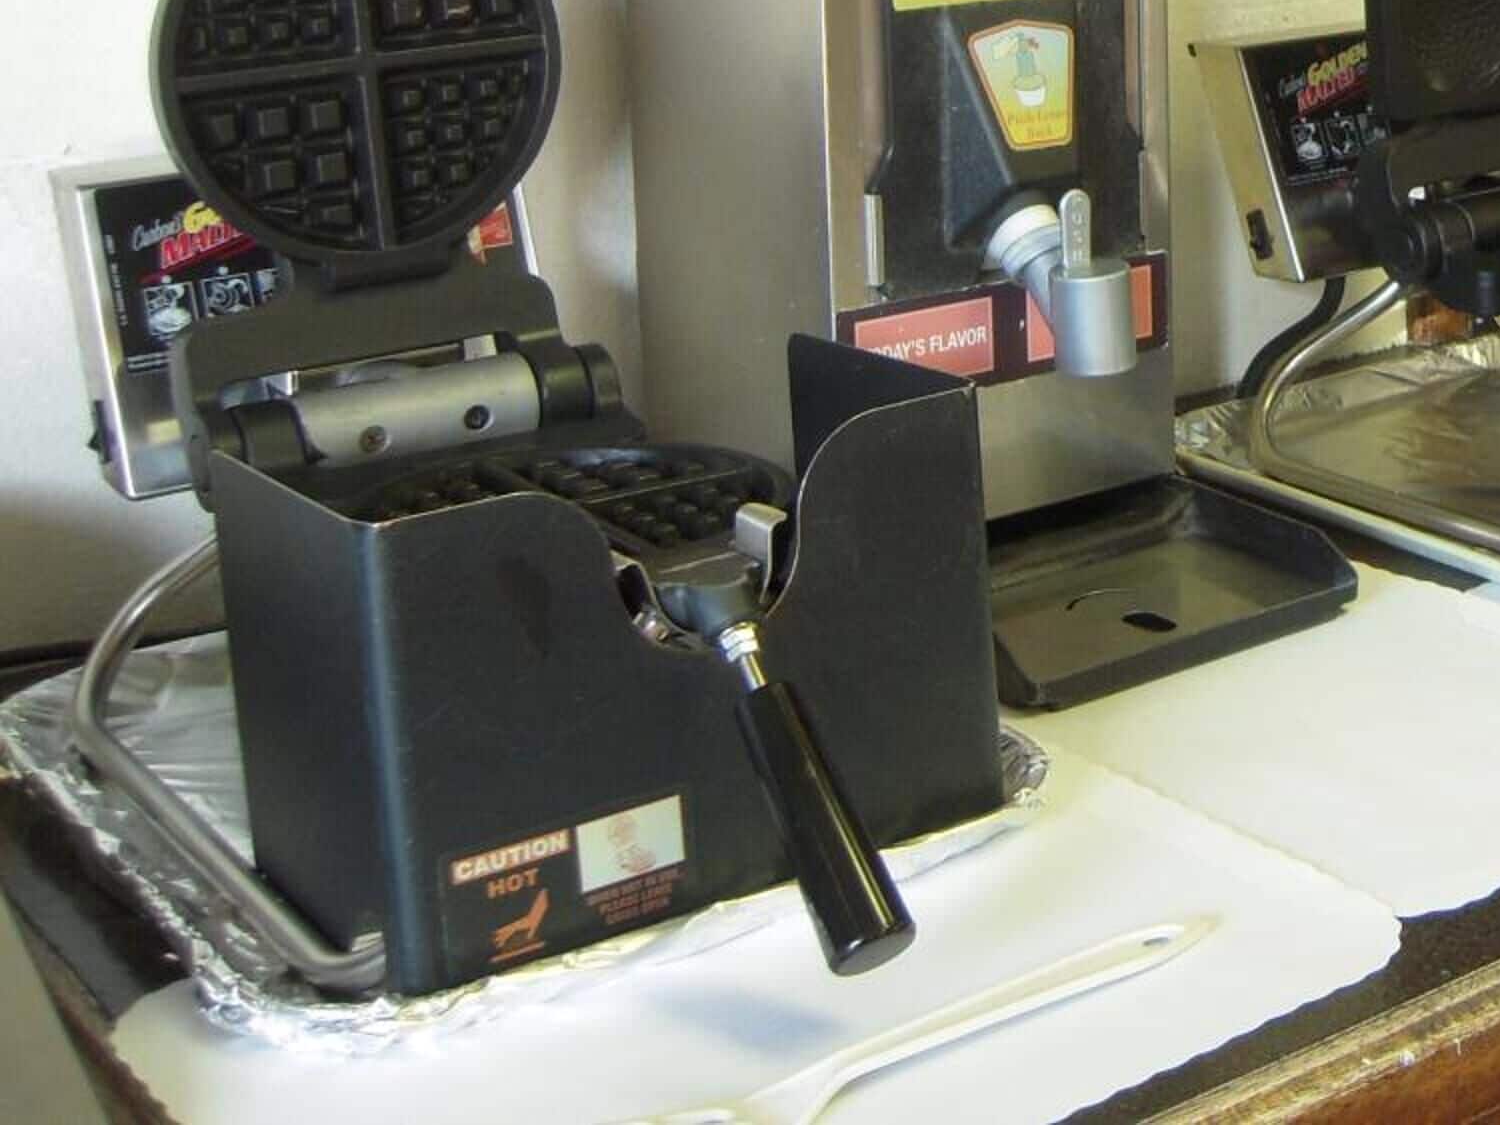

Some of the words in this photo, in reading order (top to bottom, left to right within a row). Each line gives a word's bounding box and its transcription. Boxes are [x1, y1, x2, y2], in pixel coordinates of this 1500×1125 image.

[161, 223, 243, 269] MALT
[928, 325, 987, 352] FLAVOR
[454, 831, 569, 882] CAUTION
[486, 868, 539, 899] HOT
